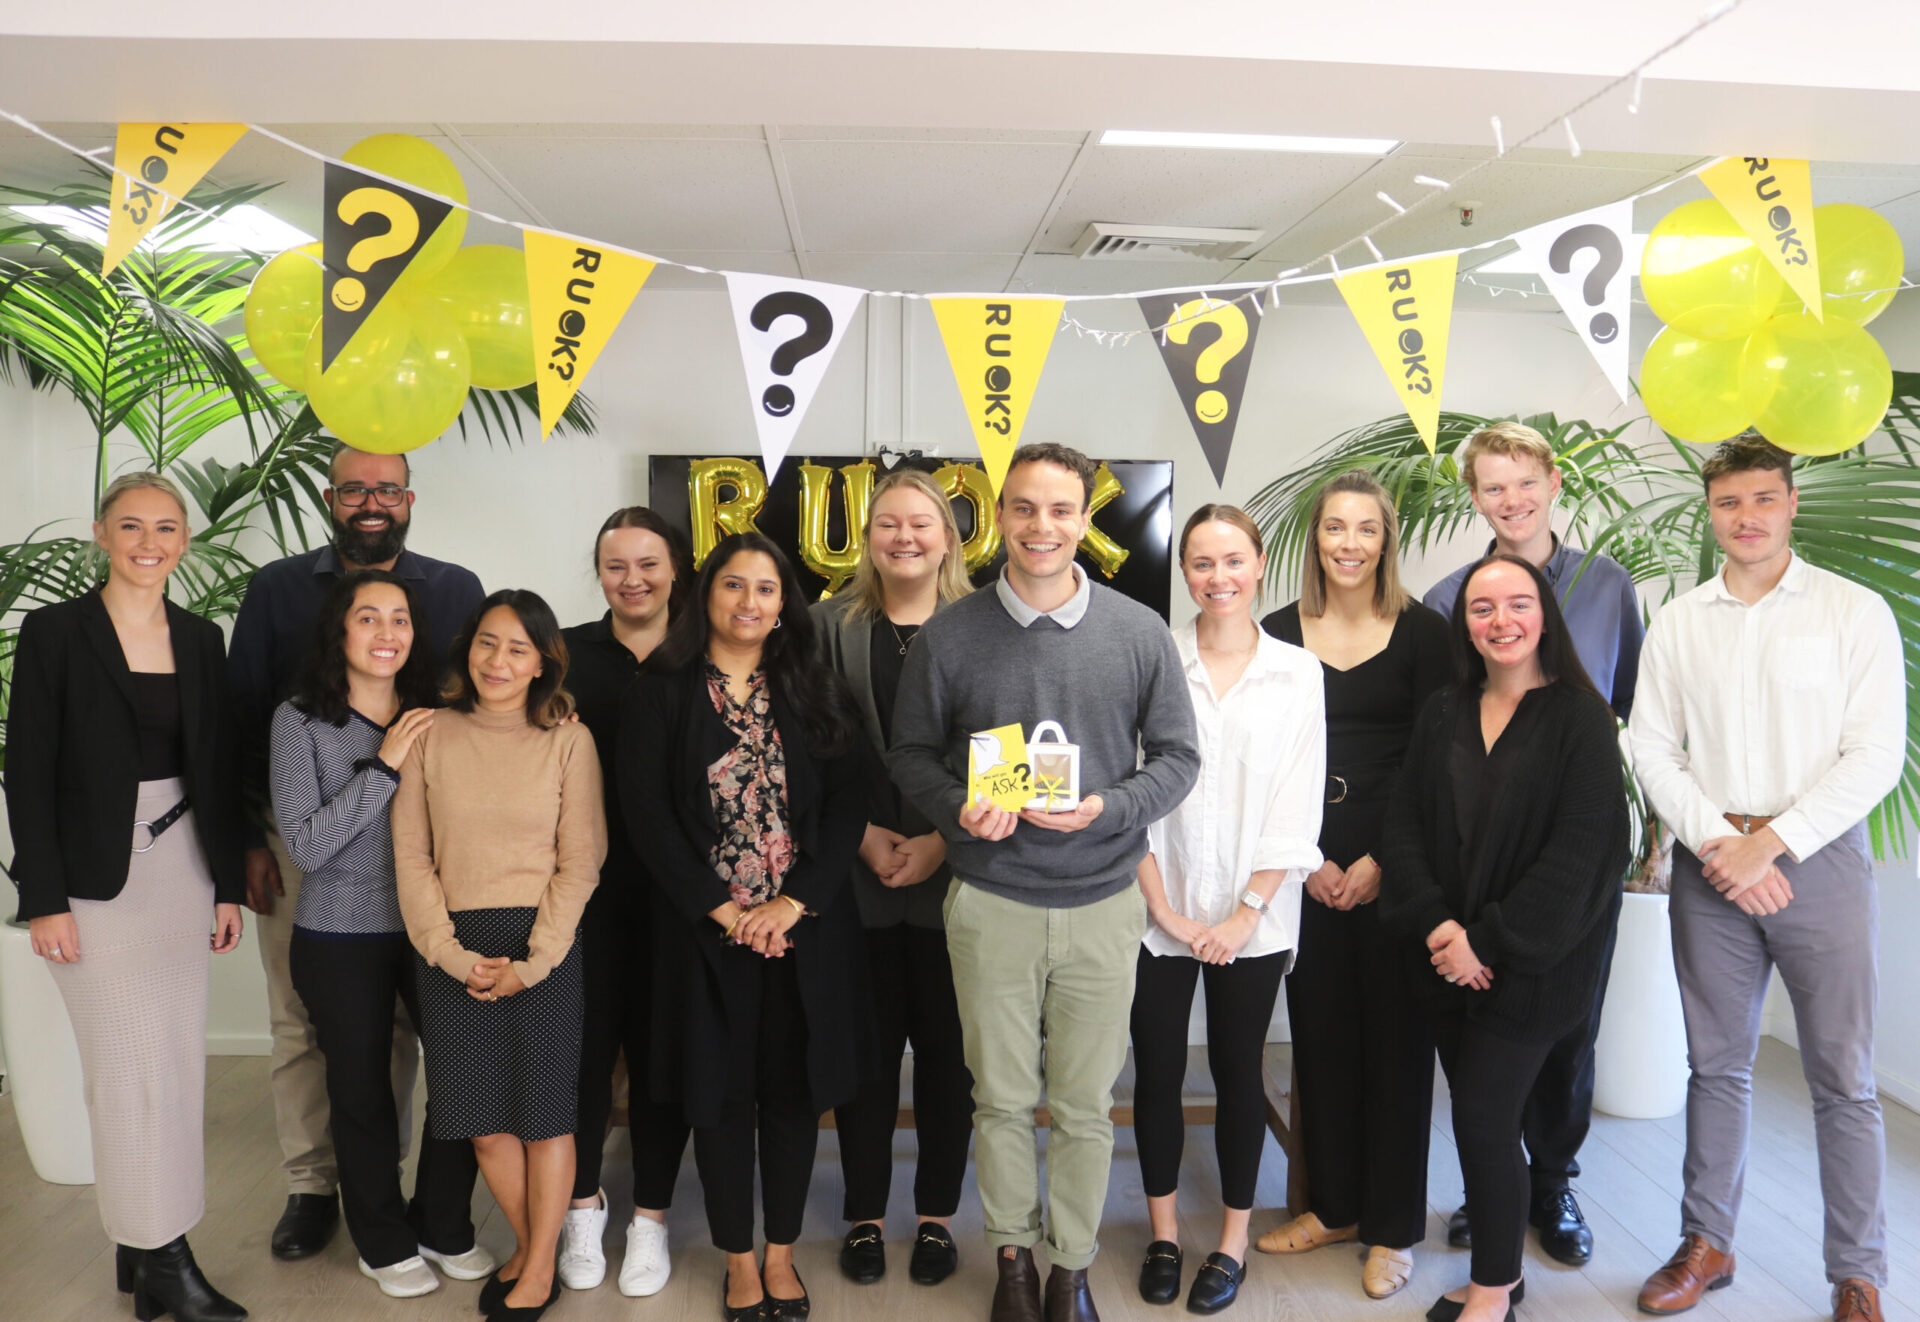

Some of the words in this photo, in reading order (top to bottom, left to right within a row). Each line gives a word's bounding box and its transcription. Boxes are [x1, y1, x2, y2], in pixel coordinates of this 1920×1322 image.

[154, 126, 185, 155] U
[1743, 157, 1769, 176] R
[1755, 175, 1782, 202] U
[1767, 205, 1808, 266] OK?
[571, 247, 602, 273] R
[566, 278, 595, 305] U
[1385, 269, 1411, 292] R
[986, 304, 1011, 326] R
[1392, 297, 1418, 321] U
[548, 309, 586, 381] OK?
[986, 334, 1011, 357] U
[1398, 328, 1432, 394] OK?
[985, 365, 1011, 435] OK?
[688, 457, 769, 571] R
[797, 458, 877, 577] U
